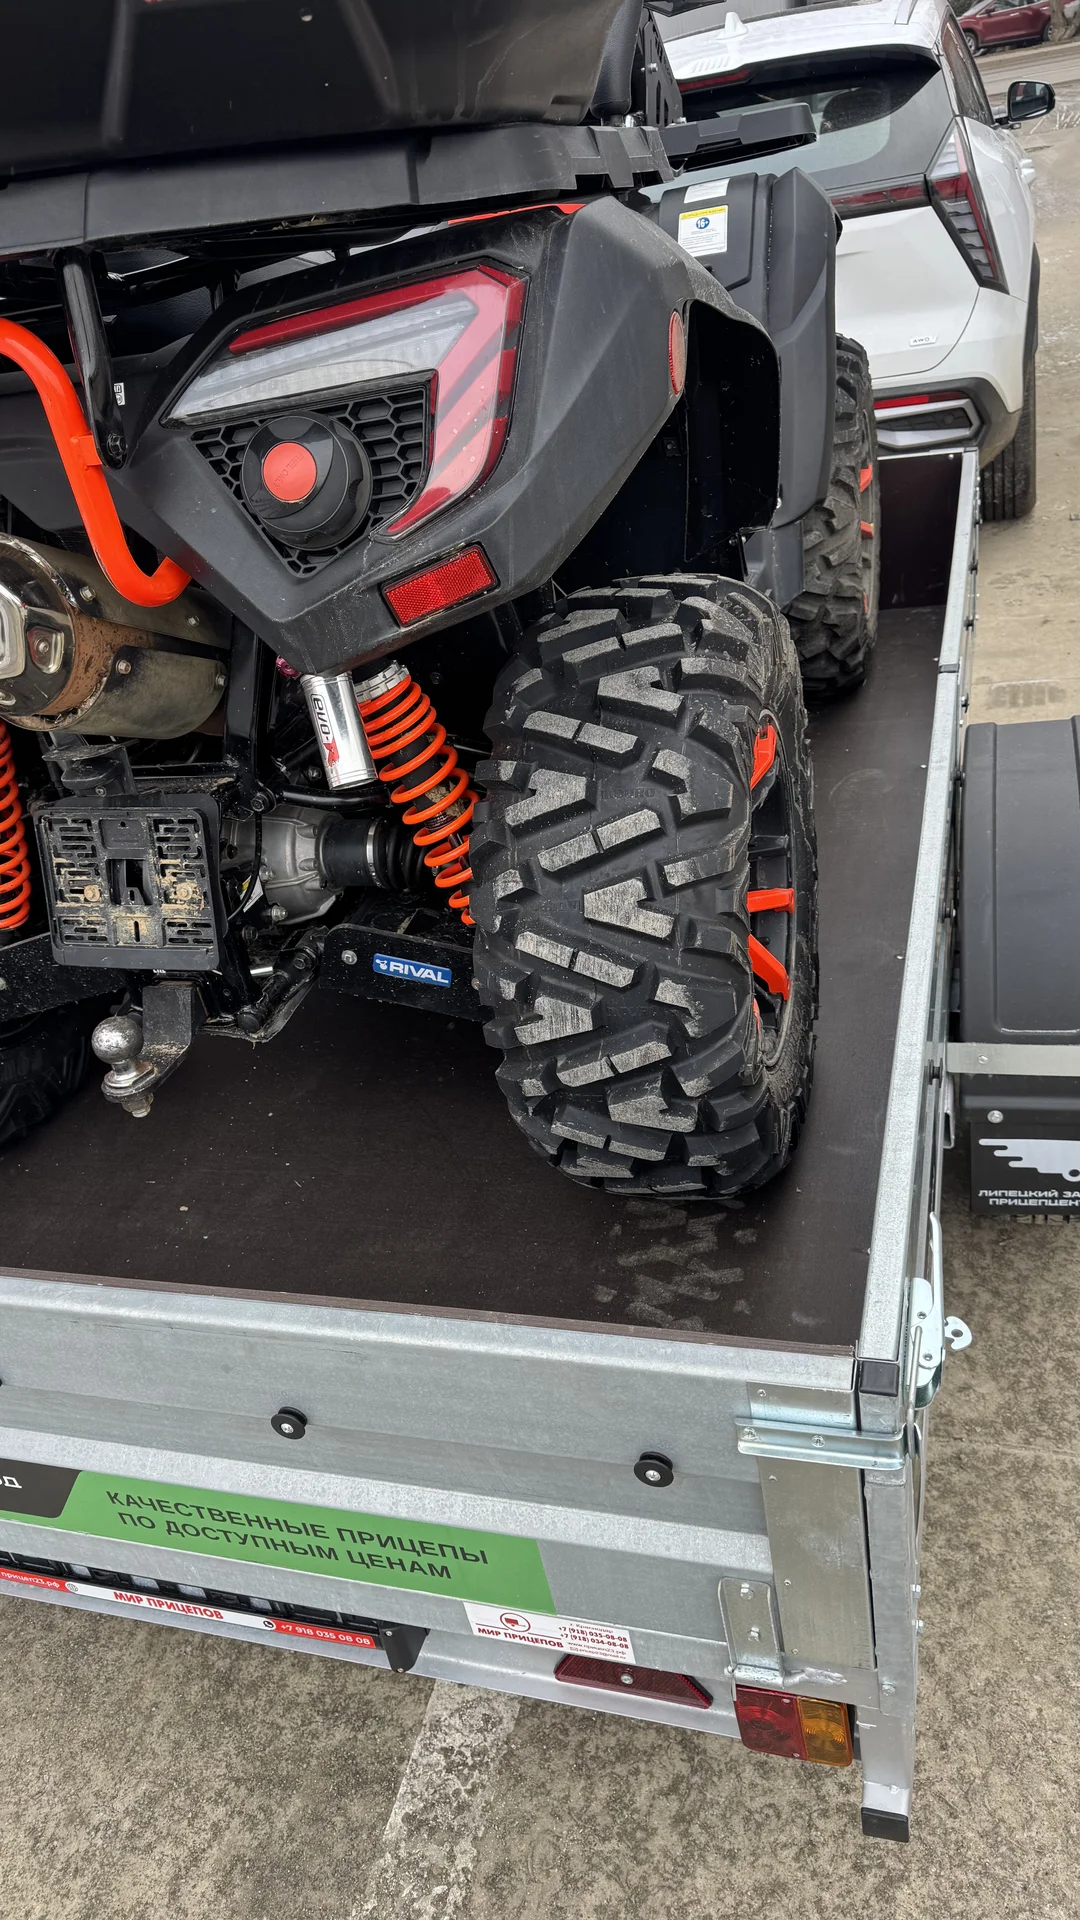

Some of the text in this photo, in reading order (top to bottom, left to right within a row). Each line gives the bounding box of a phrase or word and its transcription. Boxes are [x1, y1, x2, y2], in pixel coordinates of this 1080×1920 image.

[697, 218, 709, 228] 16+
[272, 452, 305, 489] FUEL ONLY
[389, 961, 449, 984] RIVAL
[978, 1189, 1059, 1198] ЛИПЕЦКИЙ
[989, 1198, 1080, 1207] ПРИЦЕПЦЕН
[106, 1490, 488, 1565] КАЧЕСТВЕННЫЕ ПРИЦЕПЫ
[117, 1511, 452, 1580] ПО ДОСТУПНЫМ ЦЕНАМ
[0, 1571, 60, 1589] прицеп23.рф
[113, 1591, 224, 1620] МИР ПРИЦЕПОВ
[281, 1624, 371, 1645] +7 918 035 08 08
[477, 1627, 564, 1649] МИР ПРИЦЕПОВ
[568, 1627, 588, 1636] (918)
[588, 1631, 628, 1643] 035-08-08
[570, 1634, 589, 1643] (918)
[590, 1638, 629, 1649] 034-08-08
